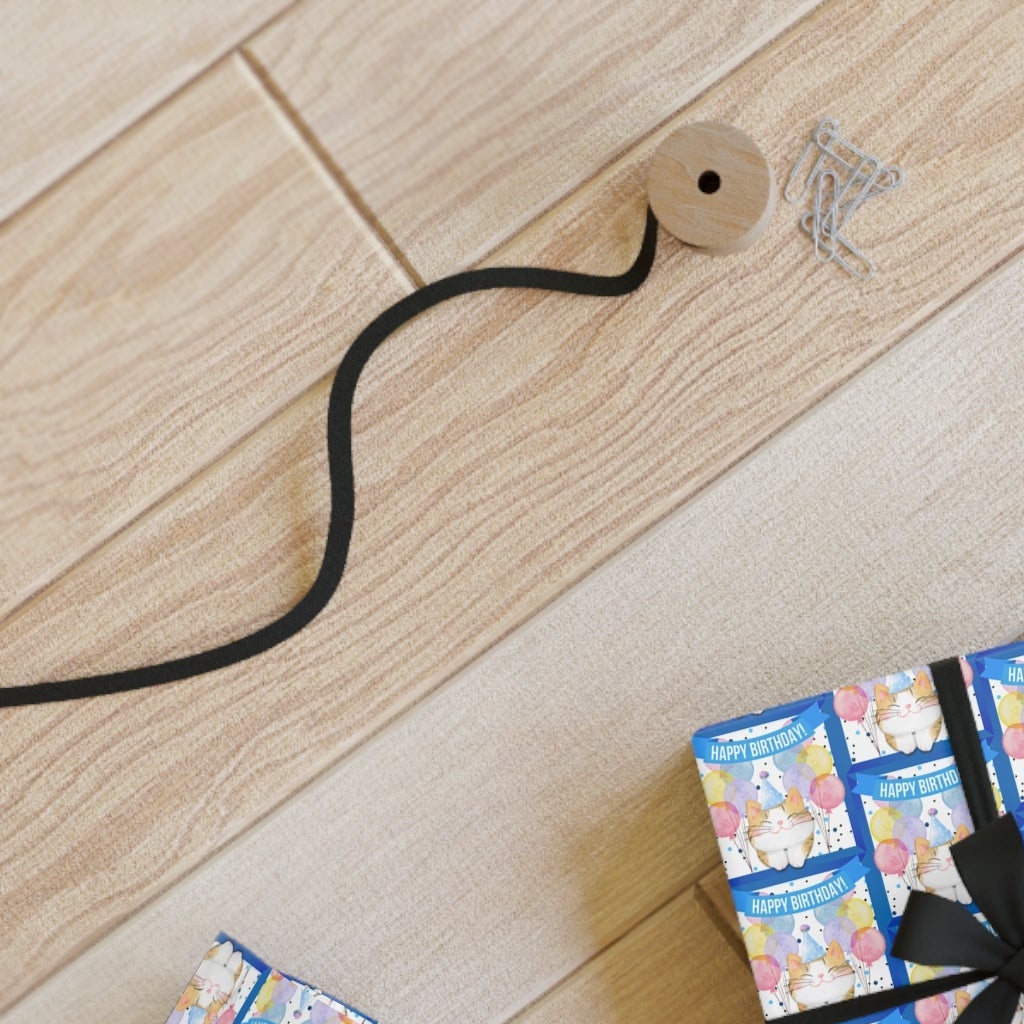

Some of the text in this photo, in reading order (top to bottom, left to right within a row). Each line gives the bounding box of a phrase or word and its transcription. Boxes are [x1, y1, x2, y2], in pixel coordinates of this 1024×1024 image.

[711, 723, 808, 760] HAPPY BIRTHDAY!
[880, 770, 958, 797] HAPPY BIRTHD
[752, 876, 848, 913] HAPPY BIRTHDAY!
